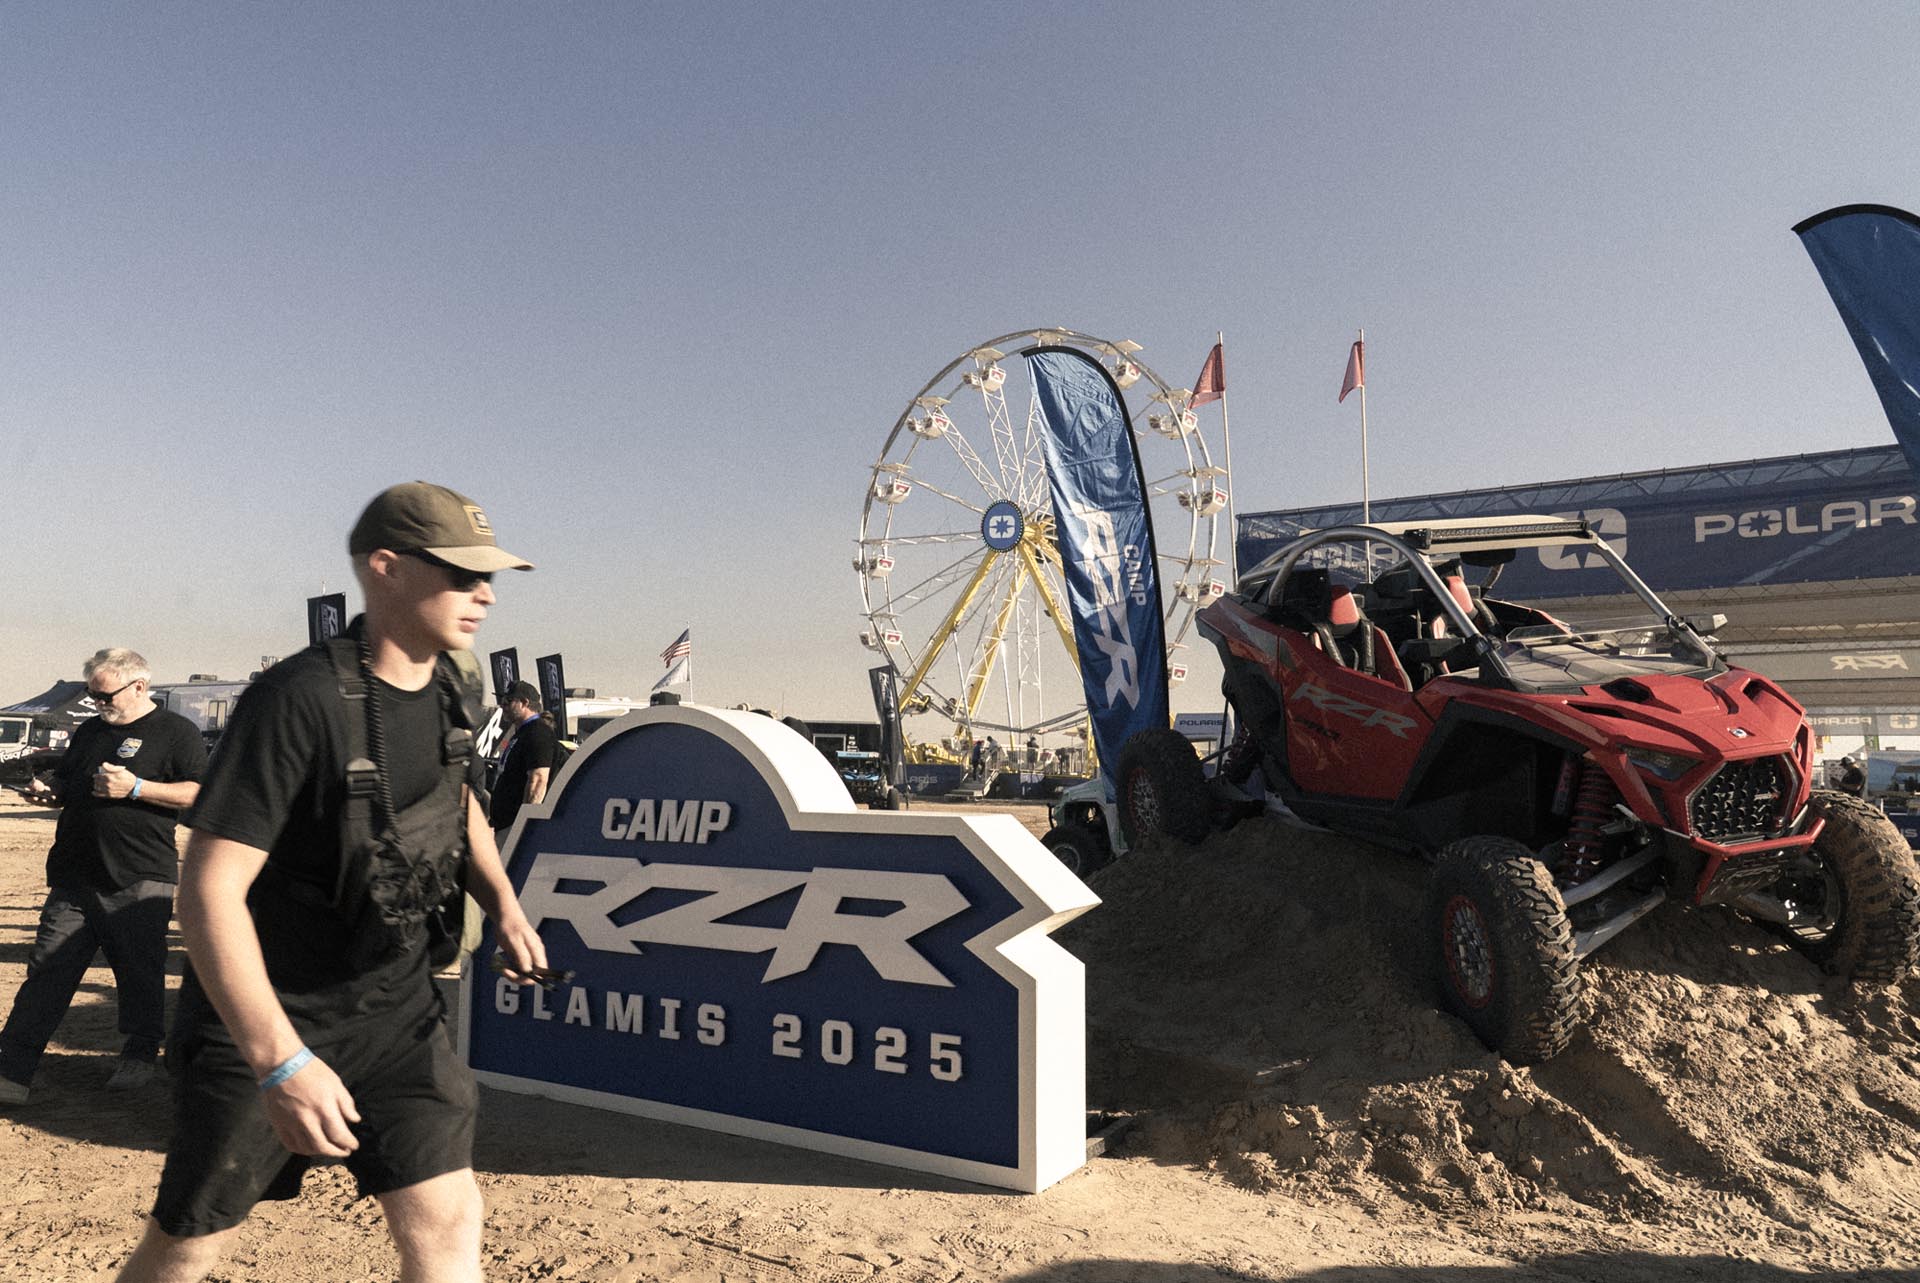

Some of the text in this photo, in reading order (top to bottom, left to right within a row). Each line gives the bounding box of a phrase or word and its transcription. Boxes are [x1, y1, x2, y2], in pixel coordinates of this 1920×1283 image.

[1069, 500, 1141, 711] RZR
[1124, 544, 1147, 606] CAMP
[1291, 682, 1418, 740] RZR
[601, 798, 731, 844] CAMP
[496, 852, 972, 988] RZR
[495, 975, 963, 1082] GLAMIS 2025
